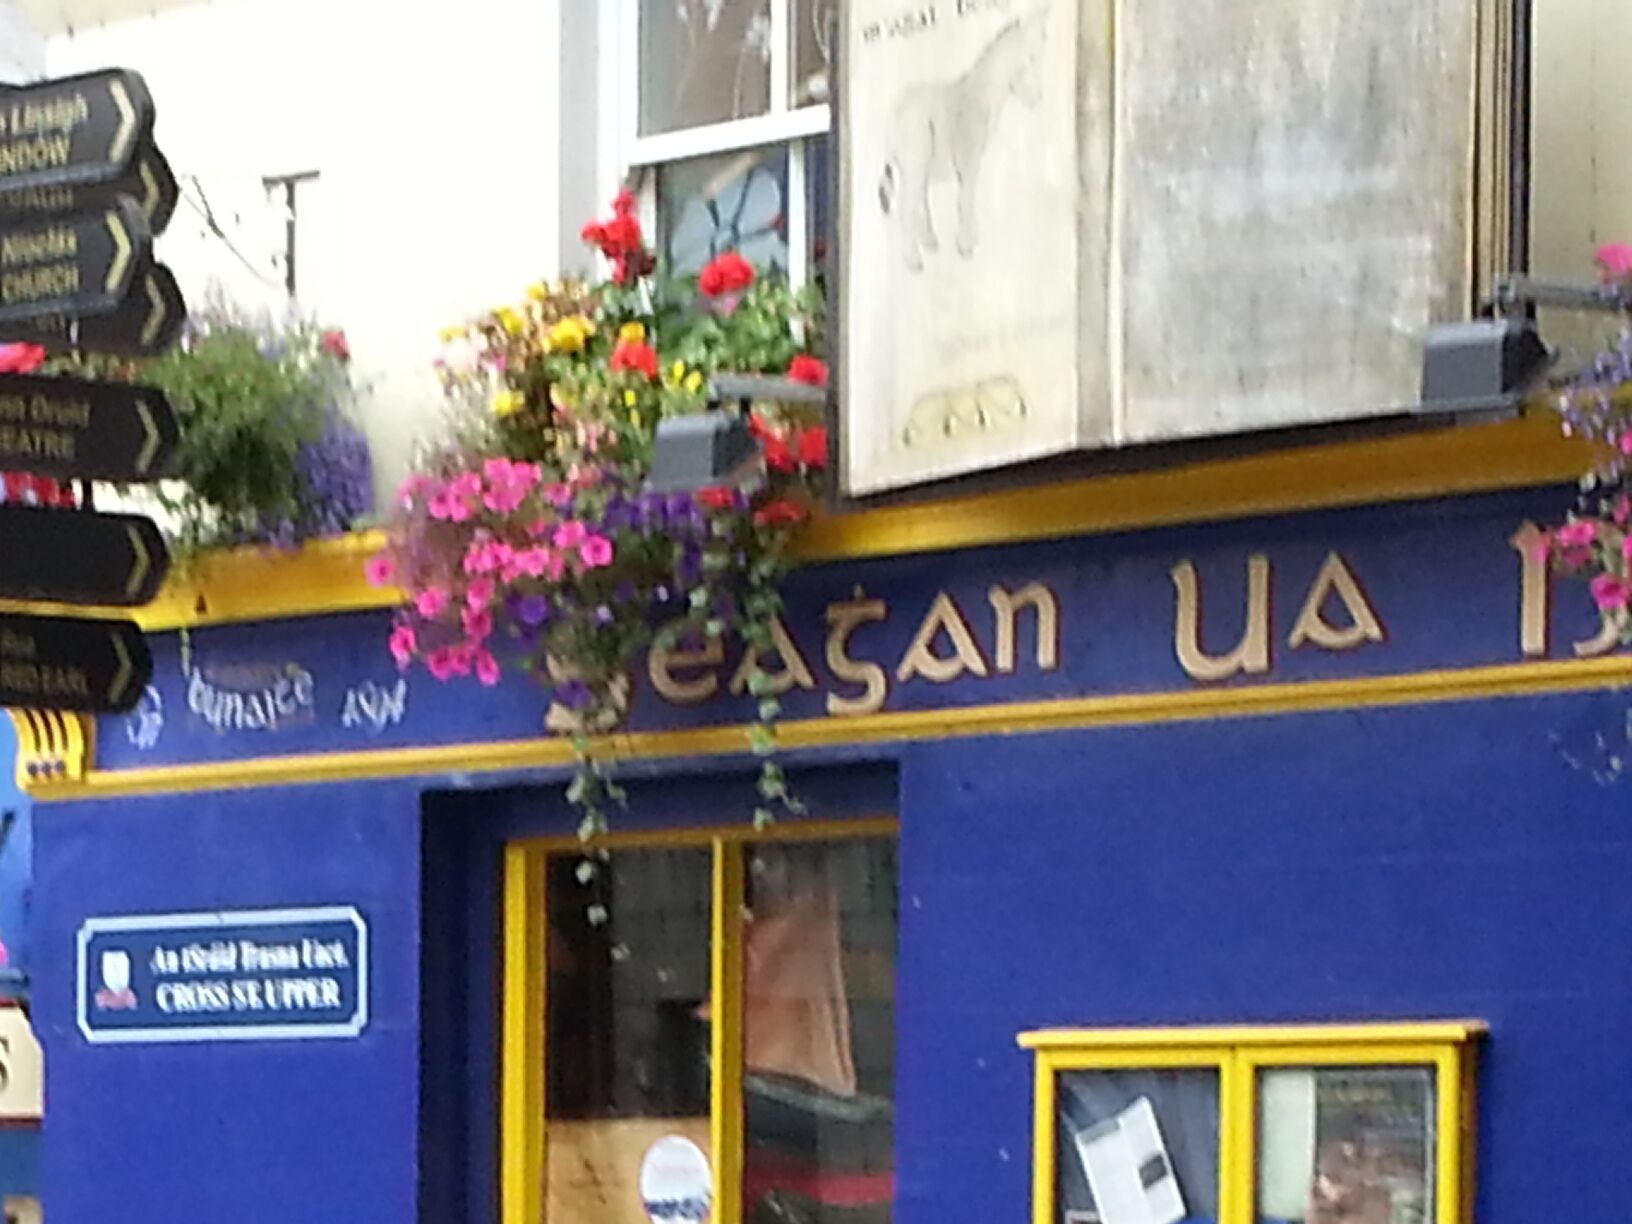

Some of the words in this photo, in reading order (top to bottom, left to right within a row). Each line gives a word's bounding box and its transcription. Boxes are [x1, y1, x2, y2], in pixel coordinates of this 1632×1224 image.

[1, 264, 79, 303] CHURCH
[156, 979, 230, 1014] CROSS
[265, 975, 342, 1011] UPPER
